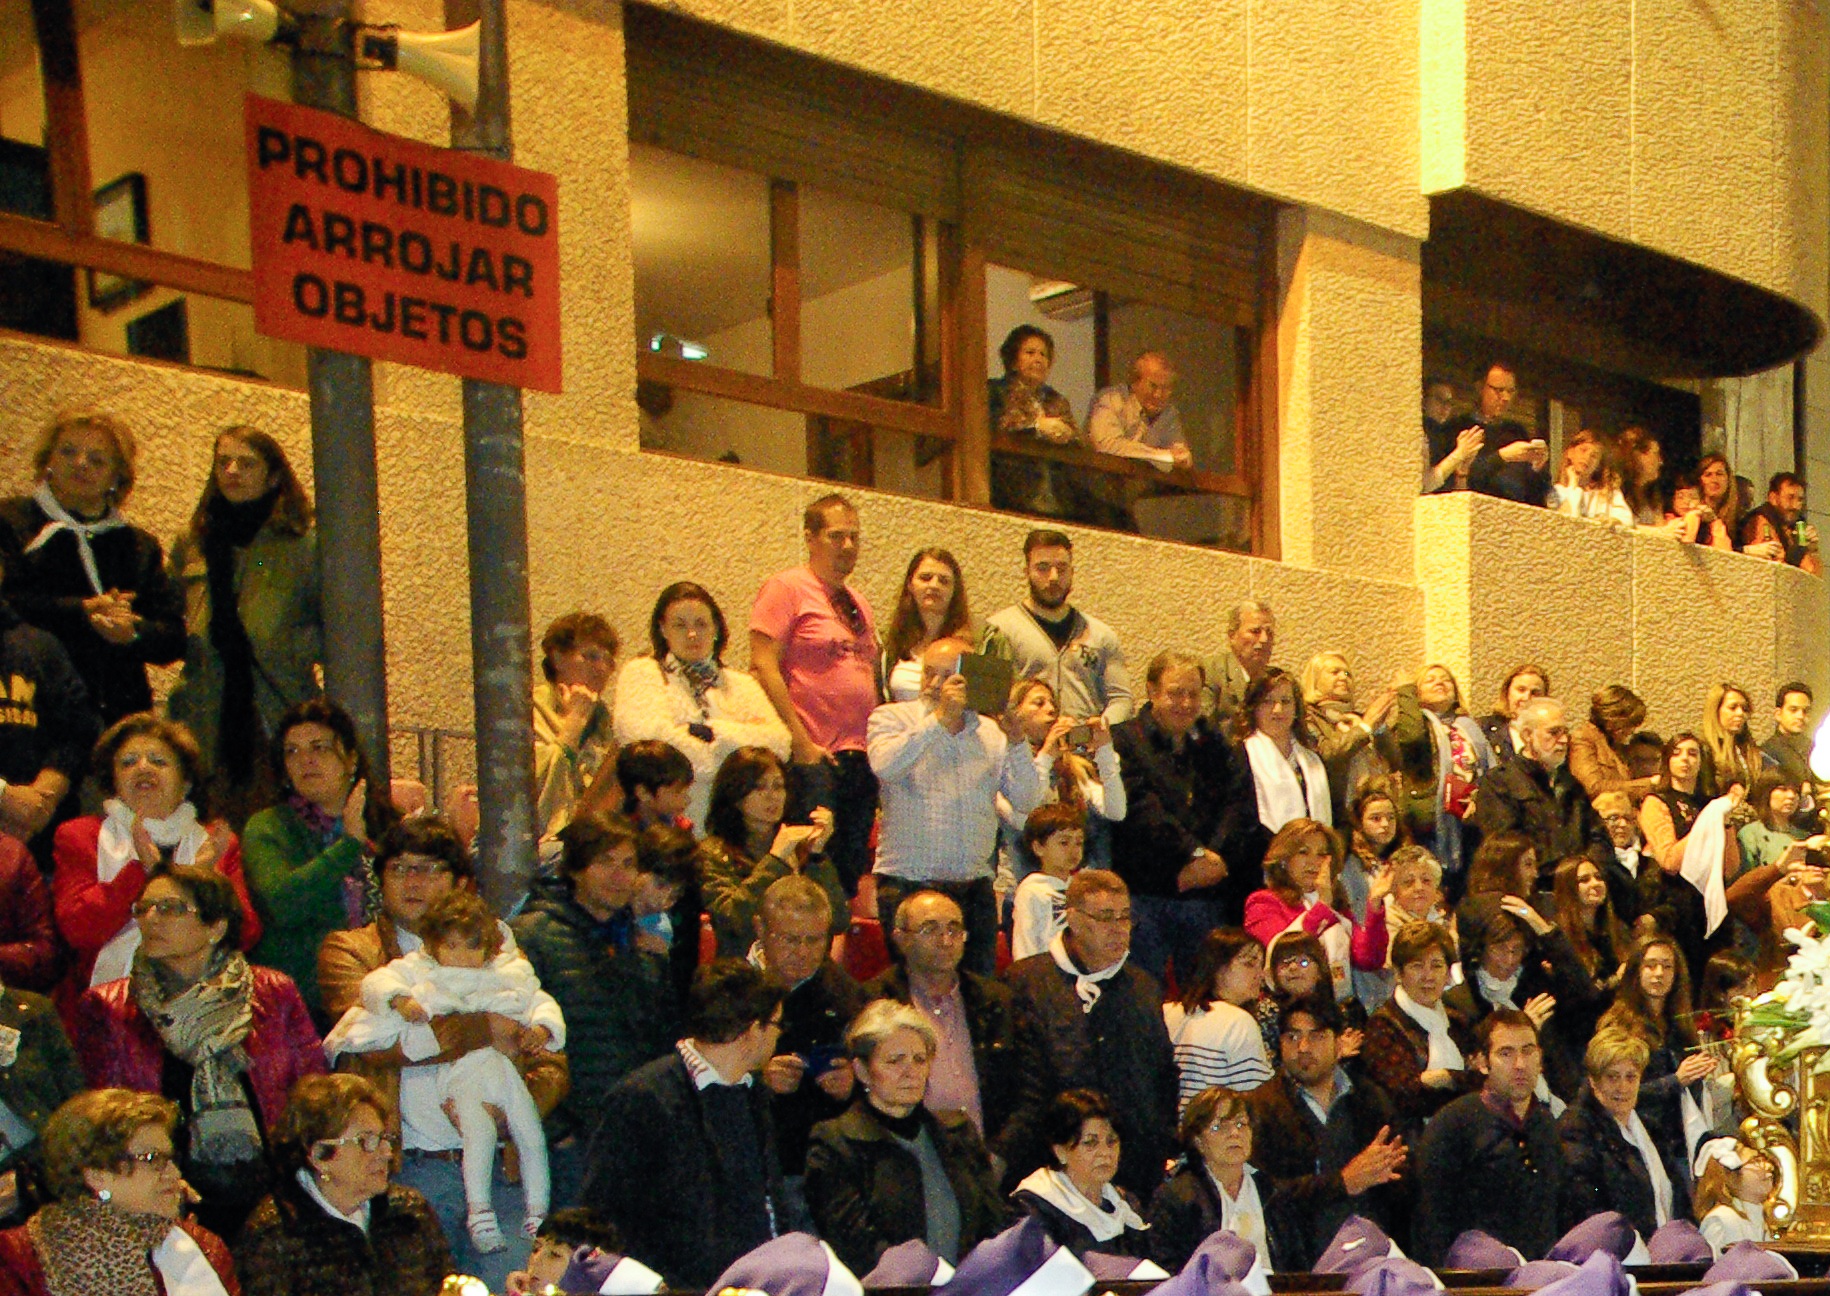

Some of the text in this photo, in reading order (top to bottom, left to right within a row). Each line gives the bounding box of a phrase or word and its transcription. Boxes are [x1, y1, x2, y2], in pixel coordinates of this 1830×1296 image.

[257, 124, 548, 236] PROHIBIDO
[282, 203, 534, 298] ARROJAR
[292, 272, 528, 360] OBJETOS
